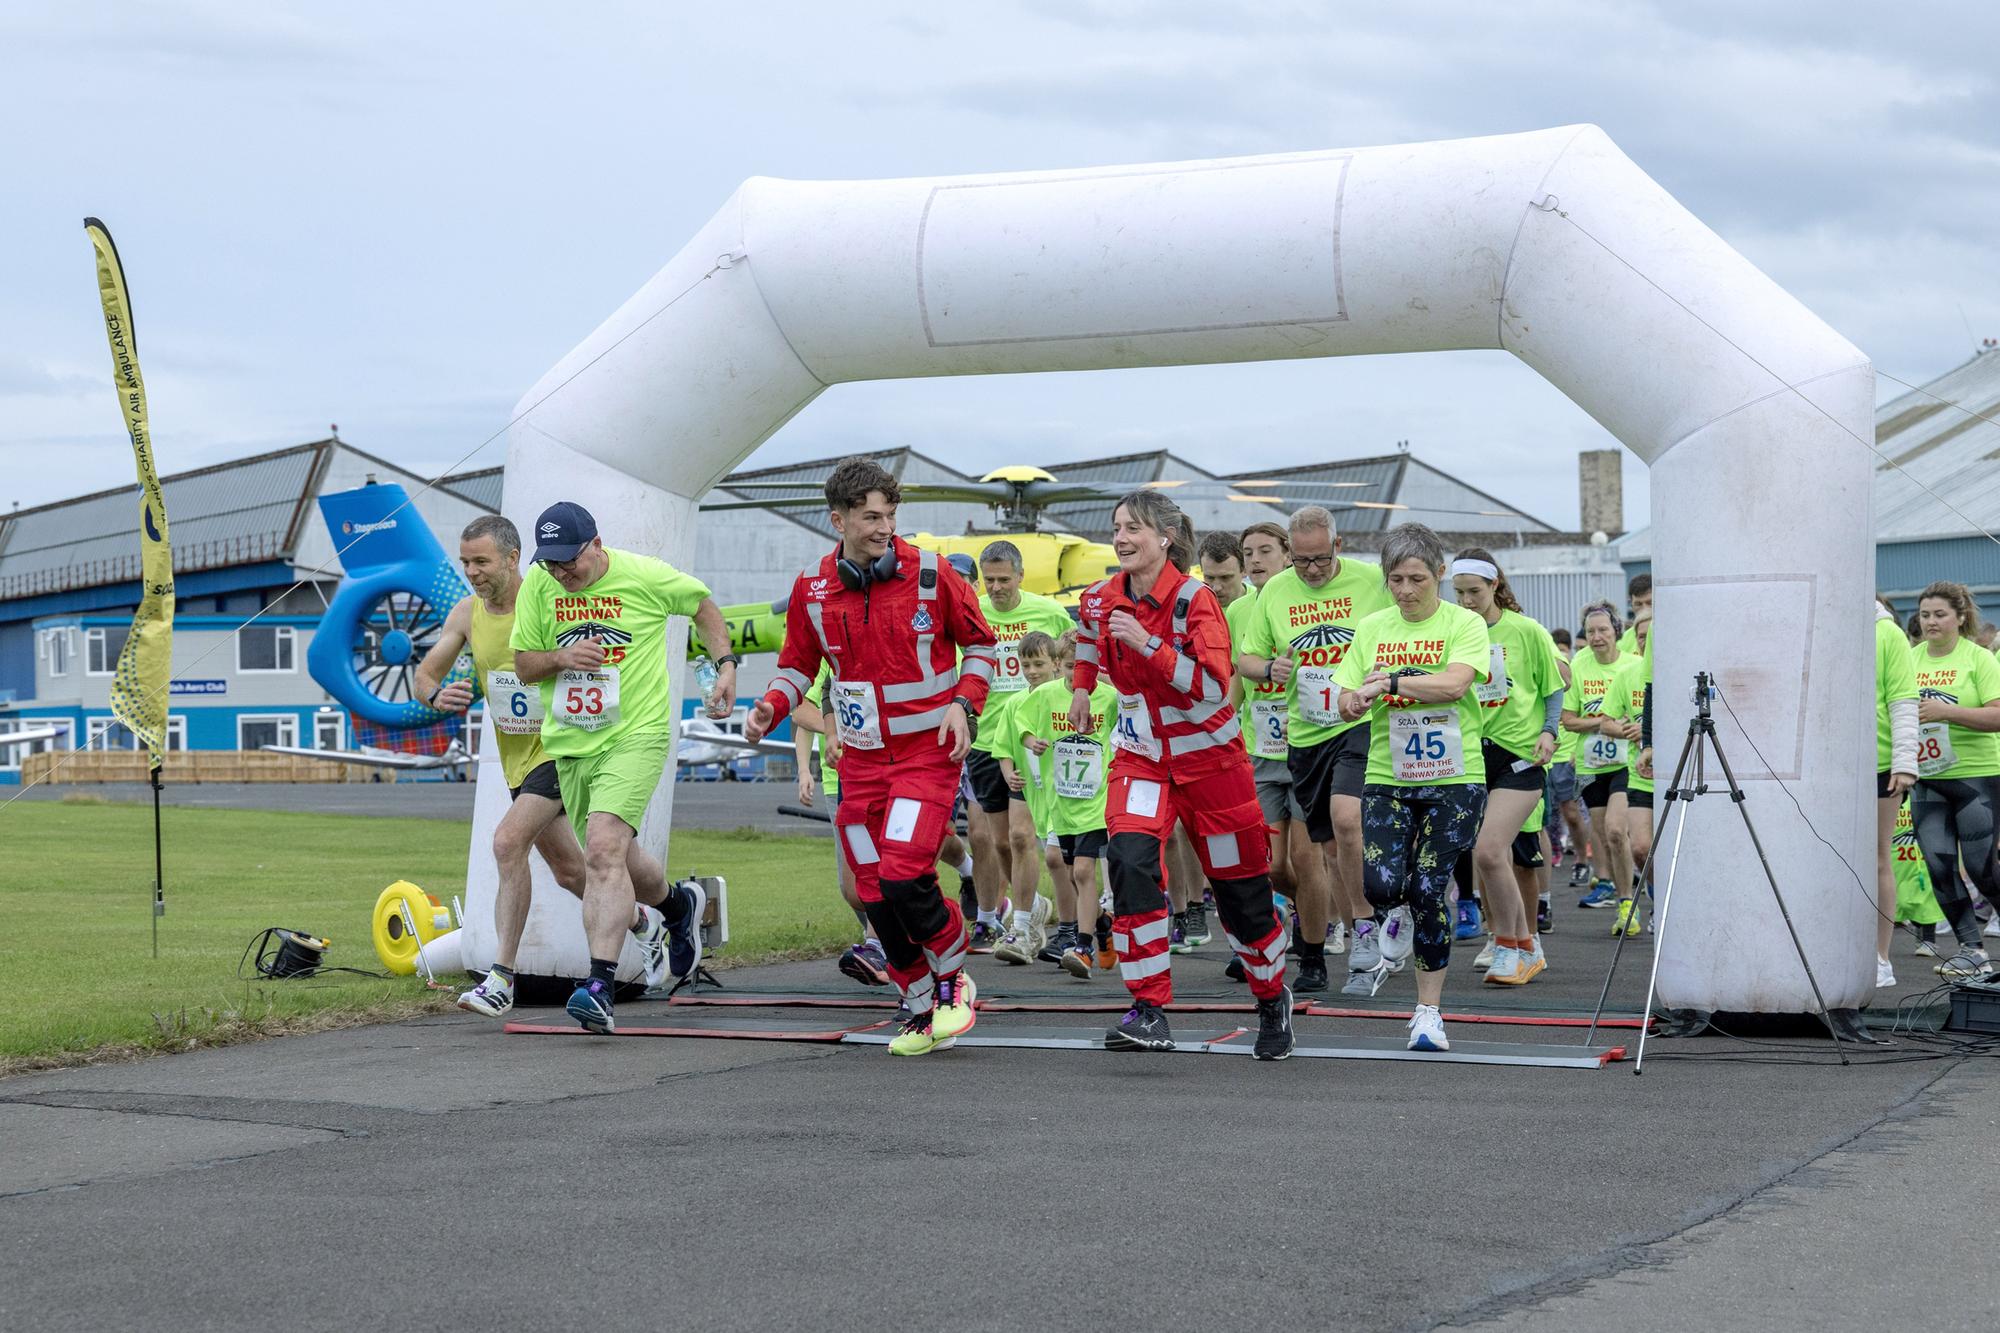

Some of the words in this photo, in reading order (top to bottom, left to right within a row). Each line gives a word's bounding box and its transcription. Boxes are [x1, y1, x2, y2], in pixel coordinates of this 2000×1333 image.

[107, 313, 139, 389] AMBULANCE
[129, 392, 141, 414] AIR
[132, 418, 150, 472] CHARITY
[555, 597, 588, 609] RUN
[591, 596, 623, 607] THE
[1289, 602, 1318, 616] RUN
[1323, 597, 1352, 609] THE
[555, 607, 623, 622] RUNWAY
[1290, 608, 1352, 627] RUNWAY
[1004, 622, 1028, 632] THE
[1377, 641, 1408, 653] RUN
[1414, 640, 1445, 652] THE
[996, 657, 1020, 677] 19
[1934, 670, 1957, 678] THE
[495, 677, 516, 685] SCAA
[1584, 679, 1604, 687] RUN
[511, 692, 528, 717] 6
[566, 687, 603, 715] 53
[1319, 688, 1331, 711] 1
[858, 731, 871, 739] THE
[1268, 716, 1282, 739] 3
[1405, 730, 1446, 760] 45
[1593, 740, 1617, 759] 49
[1061, 759, 1090, 782] 17
[1401, 770, 1435, 779] RUNWAY
[1437, 768, 1456, 777] 2025
[1402, 762, 1415, 770] 10K
[1417, 761, 1435, 769] RUN
[1437, 759, 1453, 767] THE
